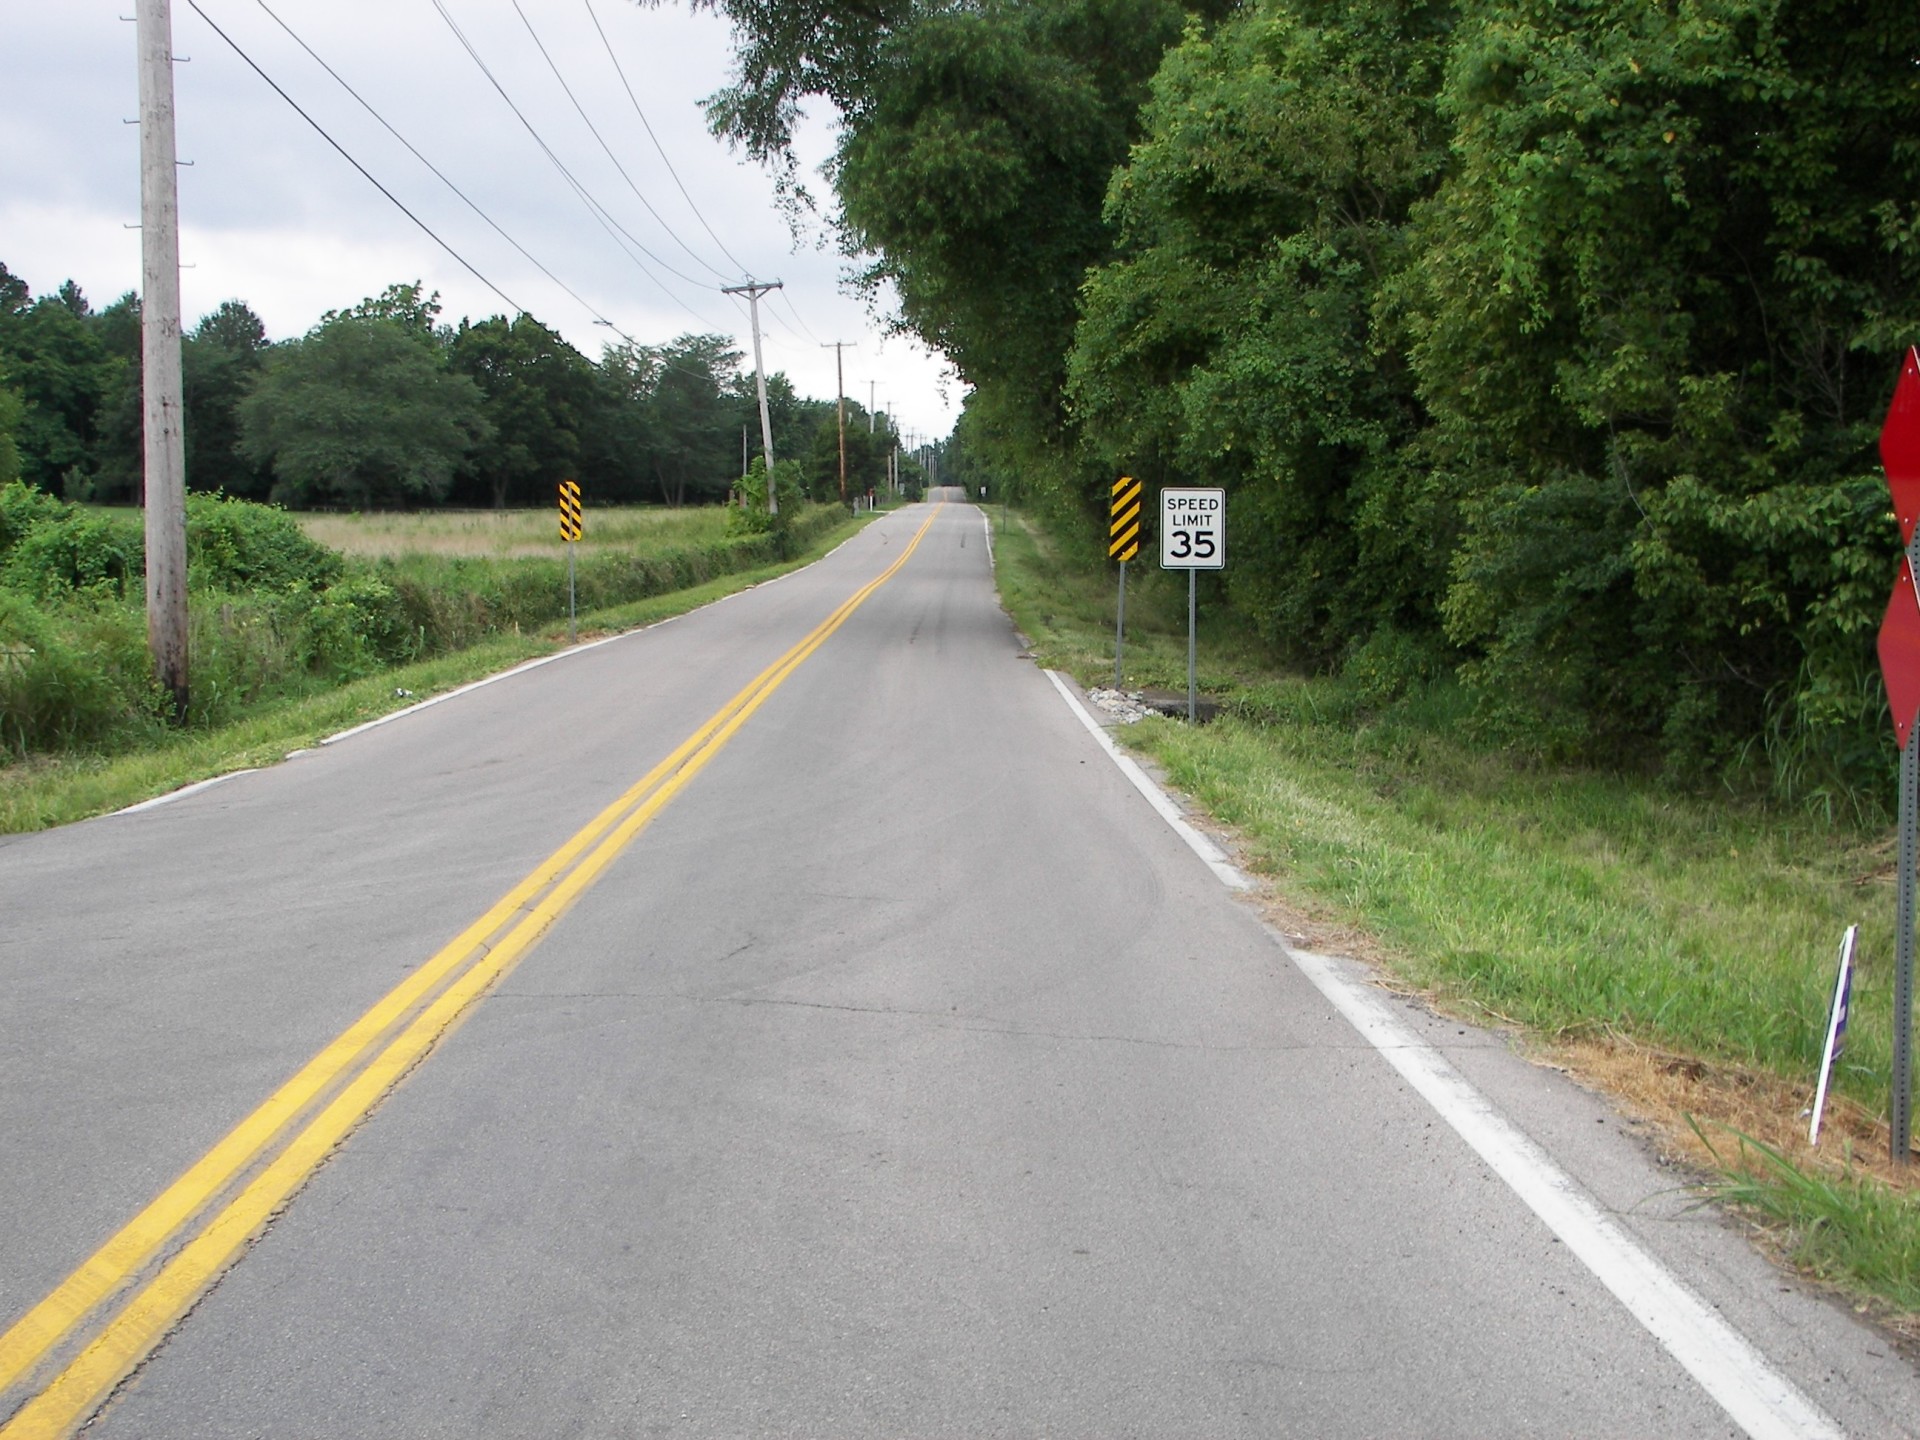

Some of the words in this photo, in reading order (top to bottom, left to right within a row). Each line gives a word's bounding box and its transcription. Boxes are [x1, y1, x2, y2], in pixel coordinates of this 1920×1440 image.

[1167, 498, 1219, 511] SPEED
[1172, 514, 1213, 527] LIMIT
[1170, 530, 1216, 559] 35
